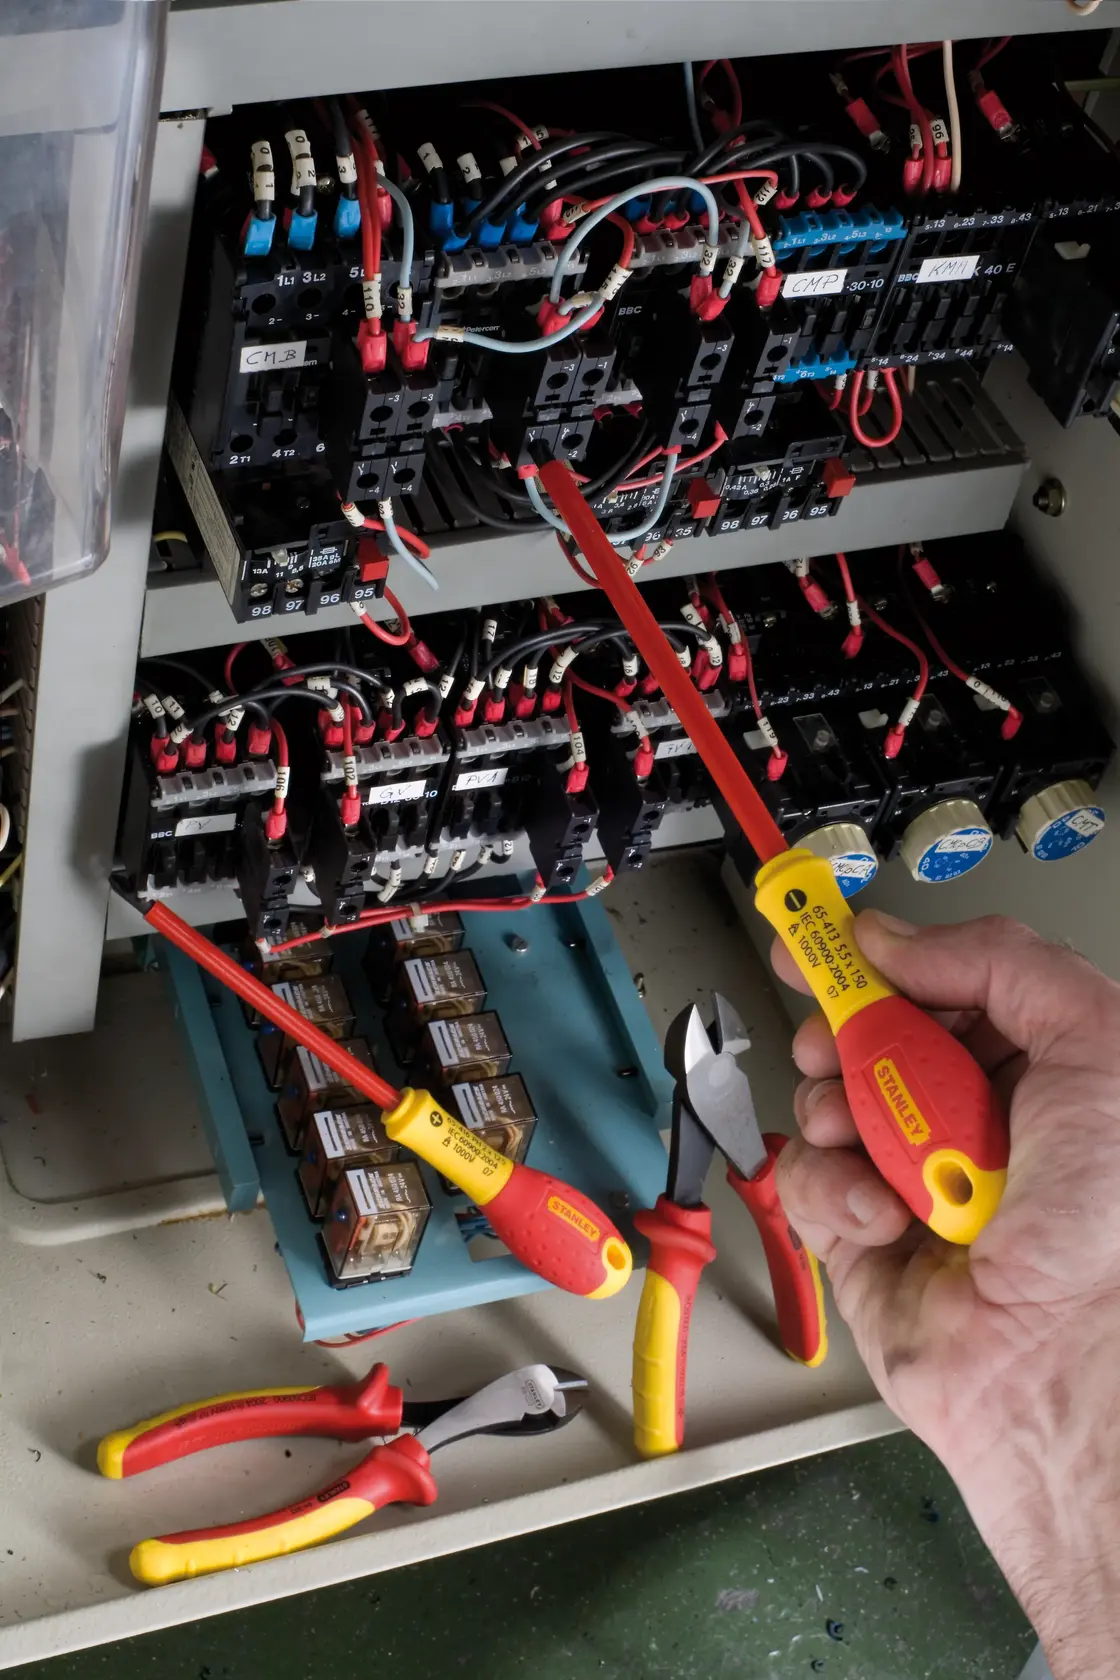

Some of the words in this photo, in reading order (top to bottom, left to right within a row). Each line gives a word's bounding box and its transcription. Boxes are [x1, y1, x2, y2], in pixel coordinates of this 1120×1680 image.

[984, 264, 1003, 275] 40
[1006, 263, 1017, 273] E
[364, 287, 375, 312] 110
[618, 306, 643, 316] BBC
[721, 520, 740, 531] 98
[751, 515, 768, 526] 97
[810, 505, 828, 516] 95
[251, 605, 272, 617] 98
[285, 600, 304, 611] 97
[320, 593, 340, 605] 96
[354, 587, 374, 599] 95
[573, 736, 584, 756] 104
[344, 760, 356, 781] 102
[150, 830, 173, 839] BBC
[797, 934, 823, 969] 1000V
[800, 911, 816, 932] IEC
[810, 929, 851, 993] 60900:2004
[811, 904, 841, 942] 65-413
[850, 969, 868, 990] 150
[826, 985, 840, 1000] 07
[876, 1063, 926, 1138] STANLEY
[448, 1127, 461, 1140] IEC
[453, 1143, 476, 1163] 1000V
[482, 1166, 495, 1177] 07
[551, 1200, 598, 1238] STANLEY
